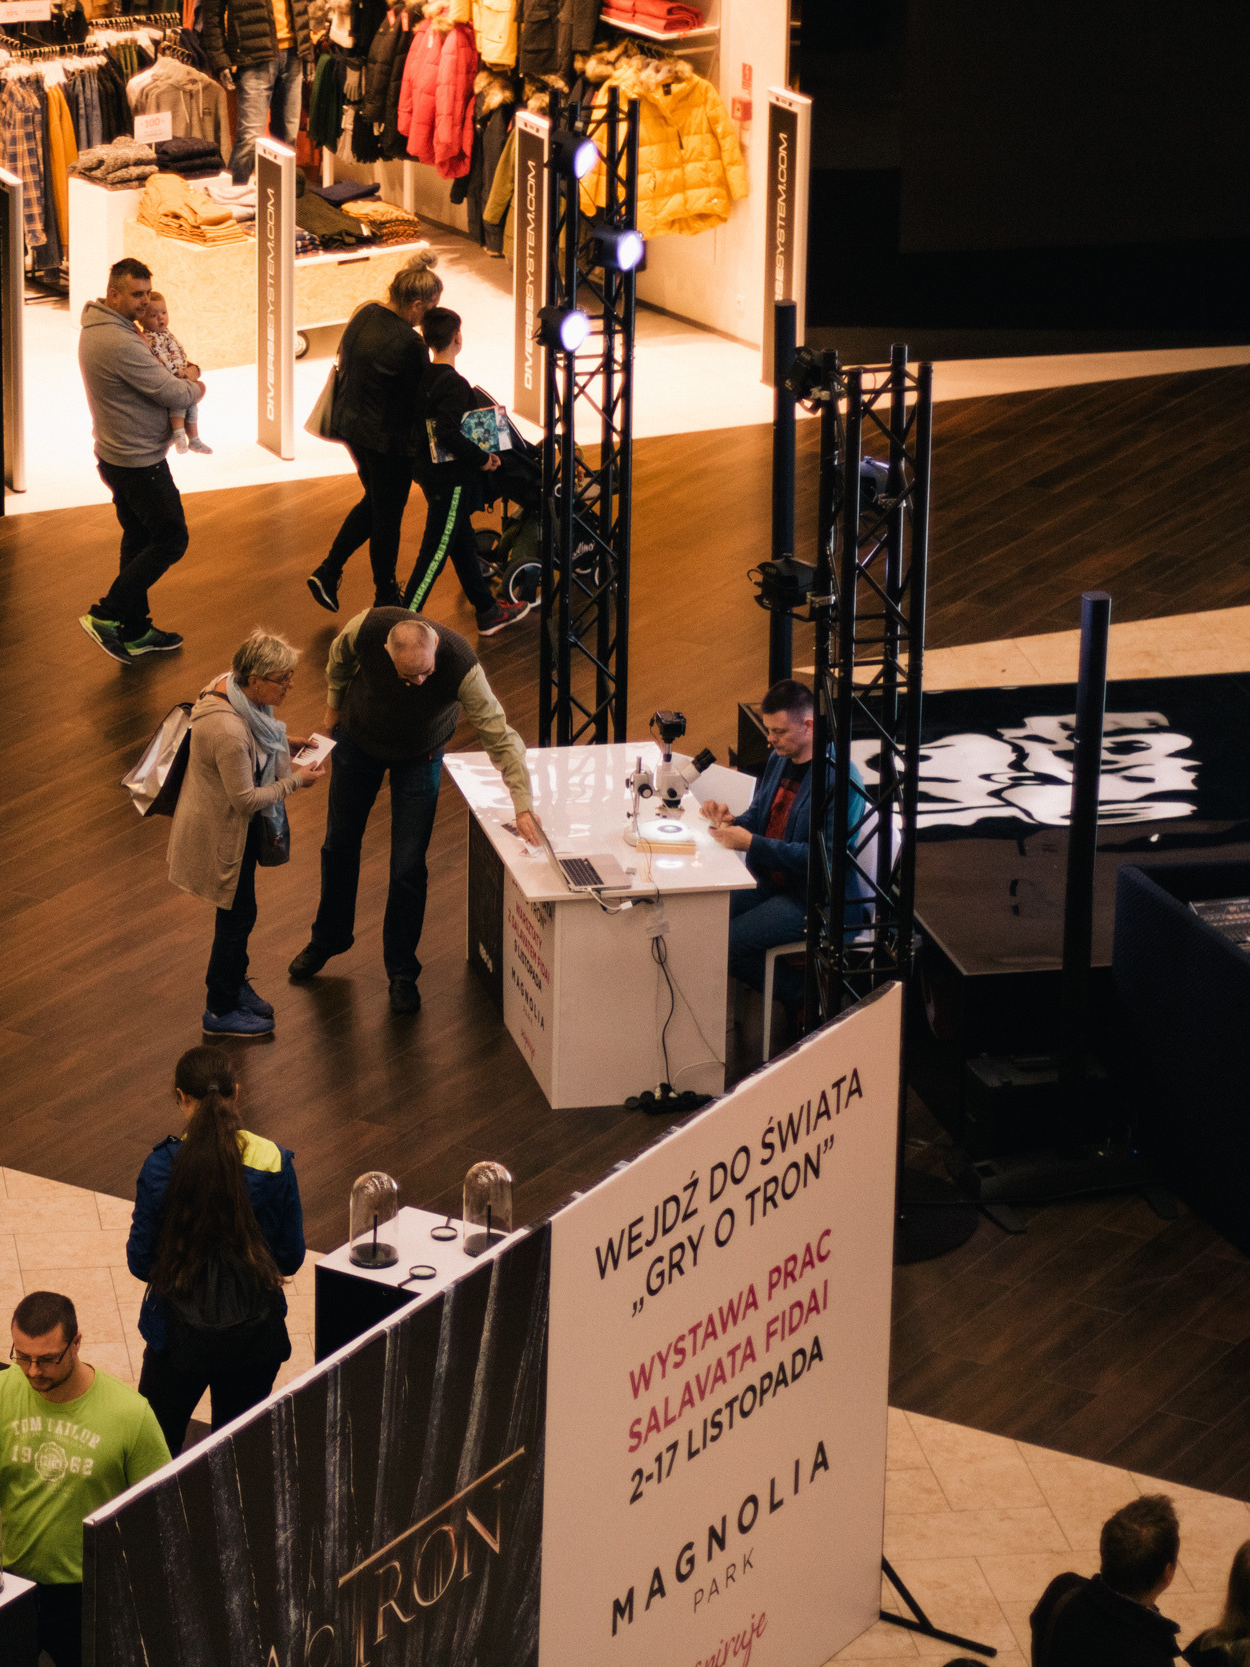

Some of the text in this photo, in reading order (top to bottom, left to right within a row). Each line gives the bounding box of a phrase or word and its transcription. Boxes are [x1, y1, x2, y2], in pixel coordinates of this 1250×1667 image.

[524, 160, 536, 390] DIVERSESYSTEM.COM
[774, 132, 788, 300] SESYSTEM.COM
[267, 188, 275, 422] DIVERSESYSTEM.COM
[511, 966, 544, 1031] MAGNOLIA
[595, 1067, 863, 1281] WEJDŹ DO ŚWIATA
[714, 1207, 736, 1248] O
[627, 1278, 829, 1453] SALAVATA FIDAI
[628, 1228, 832, 1401] WYSTAWA PRAC
[11, 1416, 42, 1435] TOM
[11, 1445, 32, 1464] 19
[69, 1456, 94, 1476] 62
[629, 1334, 824, 1506] 2-17 LISTOPADA
[611, 1439, 830, 1638] MAGNOLIA
[694, 1547, 754, 1613] PARK
